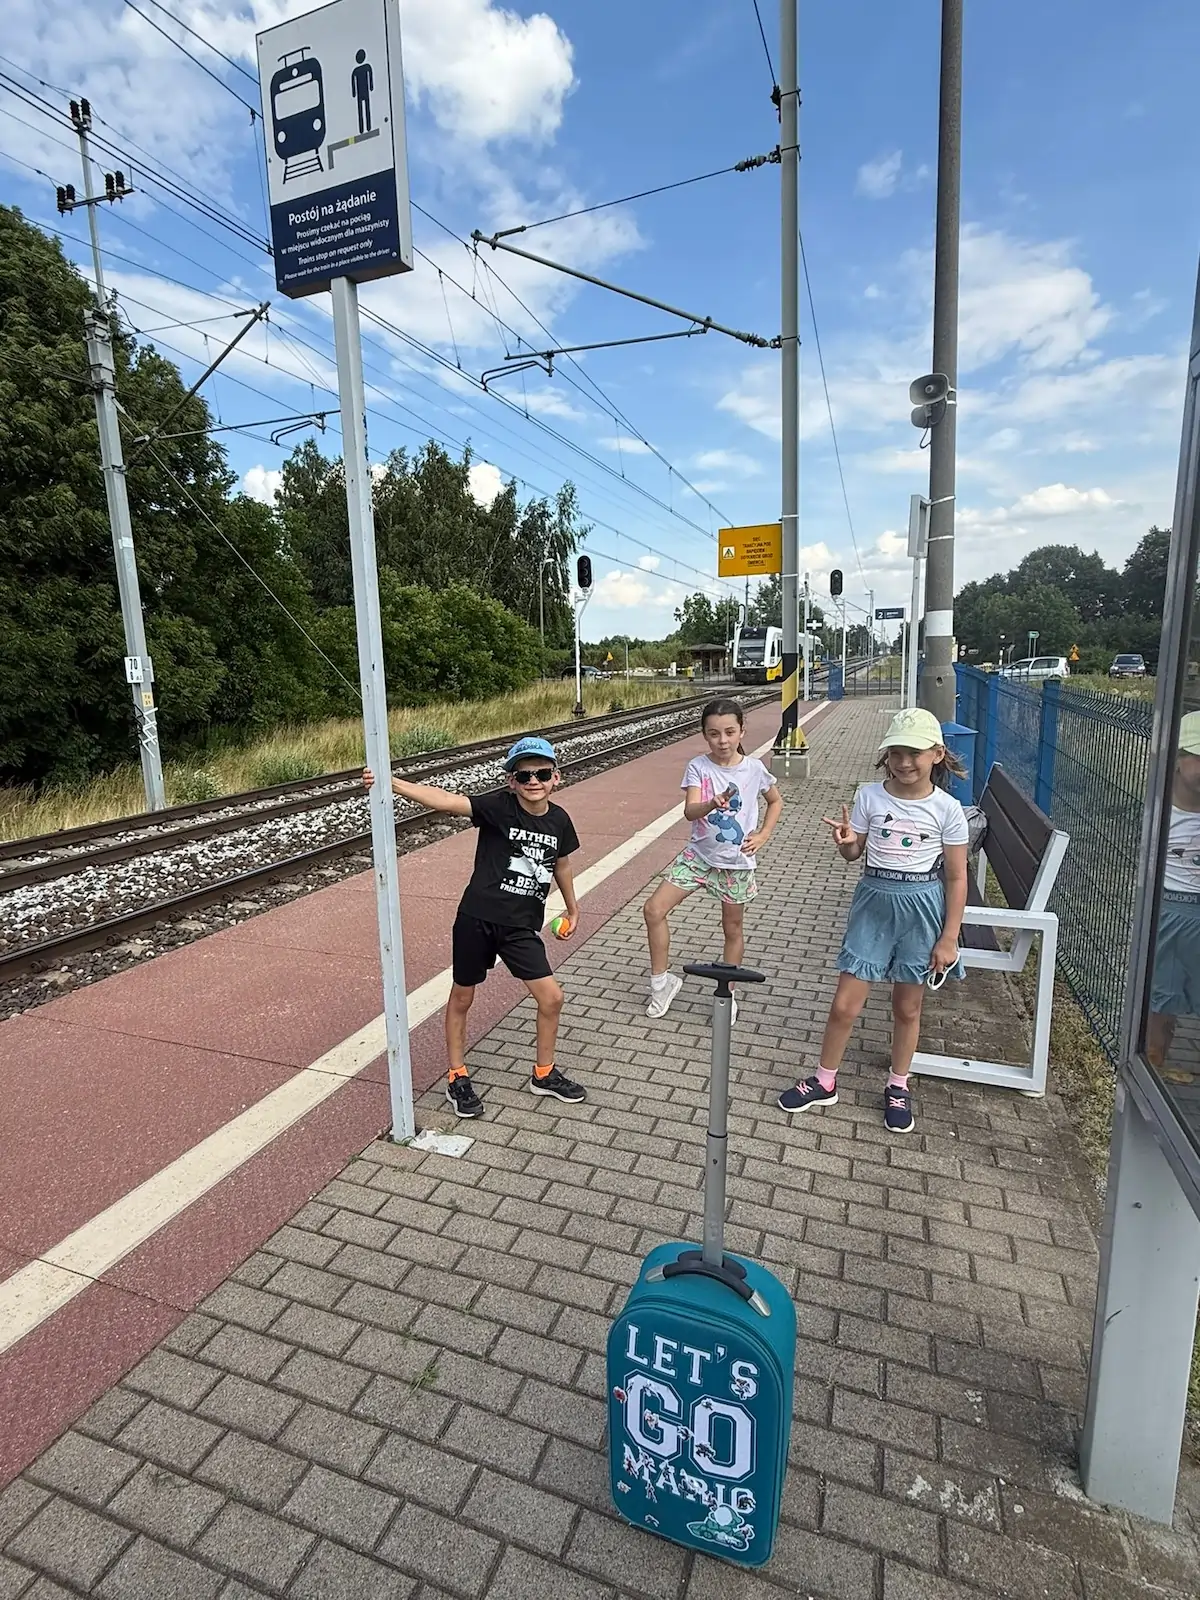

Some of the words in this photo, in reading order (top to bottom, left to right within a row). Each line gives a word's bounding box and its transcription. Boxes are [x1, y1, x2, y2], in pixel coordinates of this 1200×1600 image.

[289, 206, 320, 226] Postój
[321, 202, 334, 216] na
[336, 190, 377, 213] żądanie
[287, 241, 310, 253] miejscu
[310, 232, 344, 247] widocznym
[344, 228, 354, 237] dla
[354, 219, 390, 234] maszynisty
[296, 227, 320, 239] Prosimy
[320, 221, 340, 232] czekać
[350, 213, 371, 226] pociąg
[284, 272, 298, 280] Please
[298, 269, 307, 277] wait
[320, 262, 330, 271] train
[339, 257, 350, 267] place
[350, 253, 364, 263] visible
[369, 250, 377, 258] the
[377, 248, 391, 257] driver
[298, 255, 315, 266] Trains
[315, 252, 329, 261] stop
[337, 244, 360, 256] request
[360, 239, 373, 249] only
[878, 611, 884, 619] 2
[129, 658, 138, 670] 70
[508, 827, 558, 850] FATHER
[521, 846, 545, 861] SON
[500, 883, 527, 896] FRIENDS
[515, 875, 541, 891] BEST
[625, 1323, 758, 1399] LET'S
[624, 1370, 757, 1482] GO
